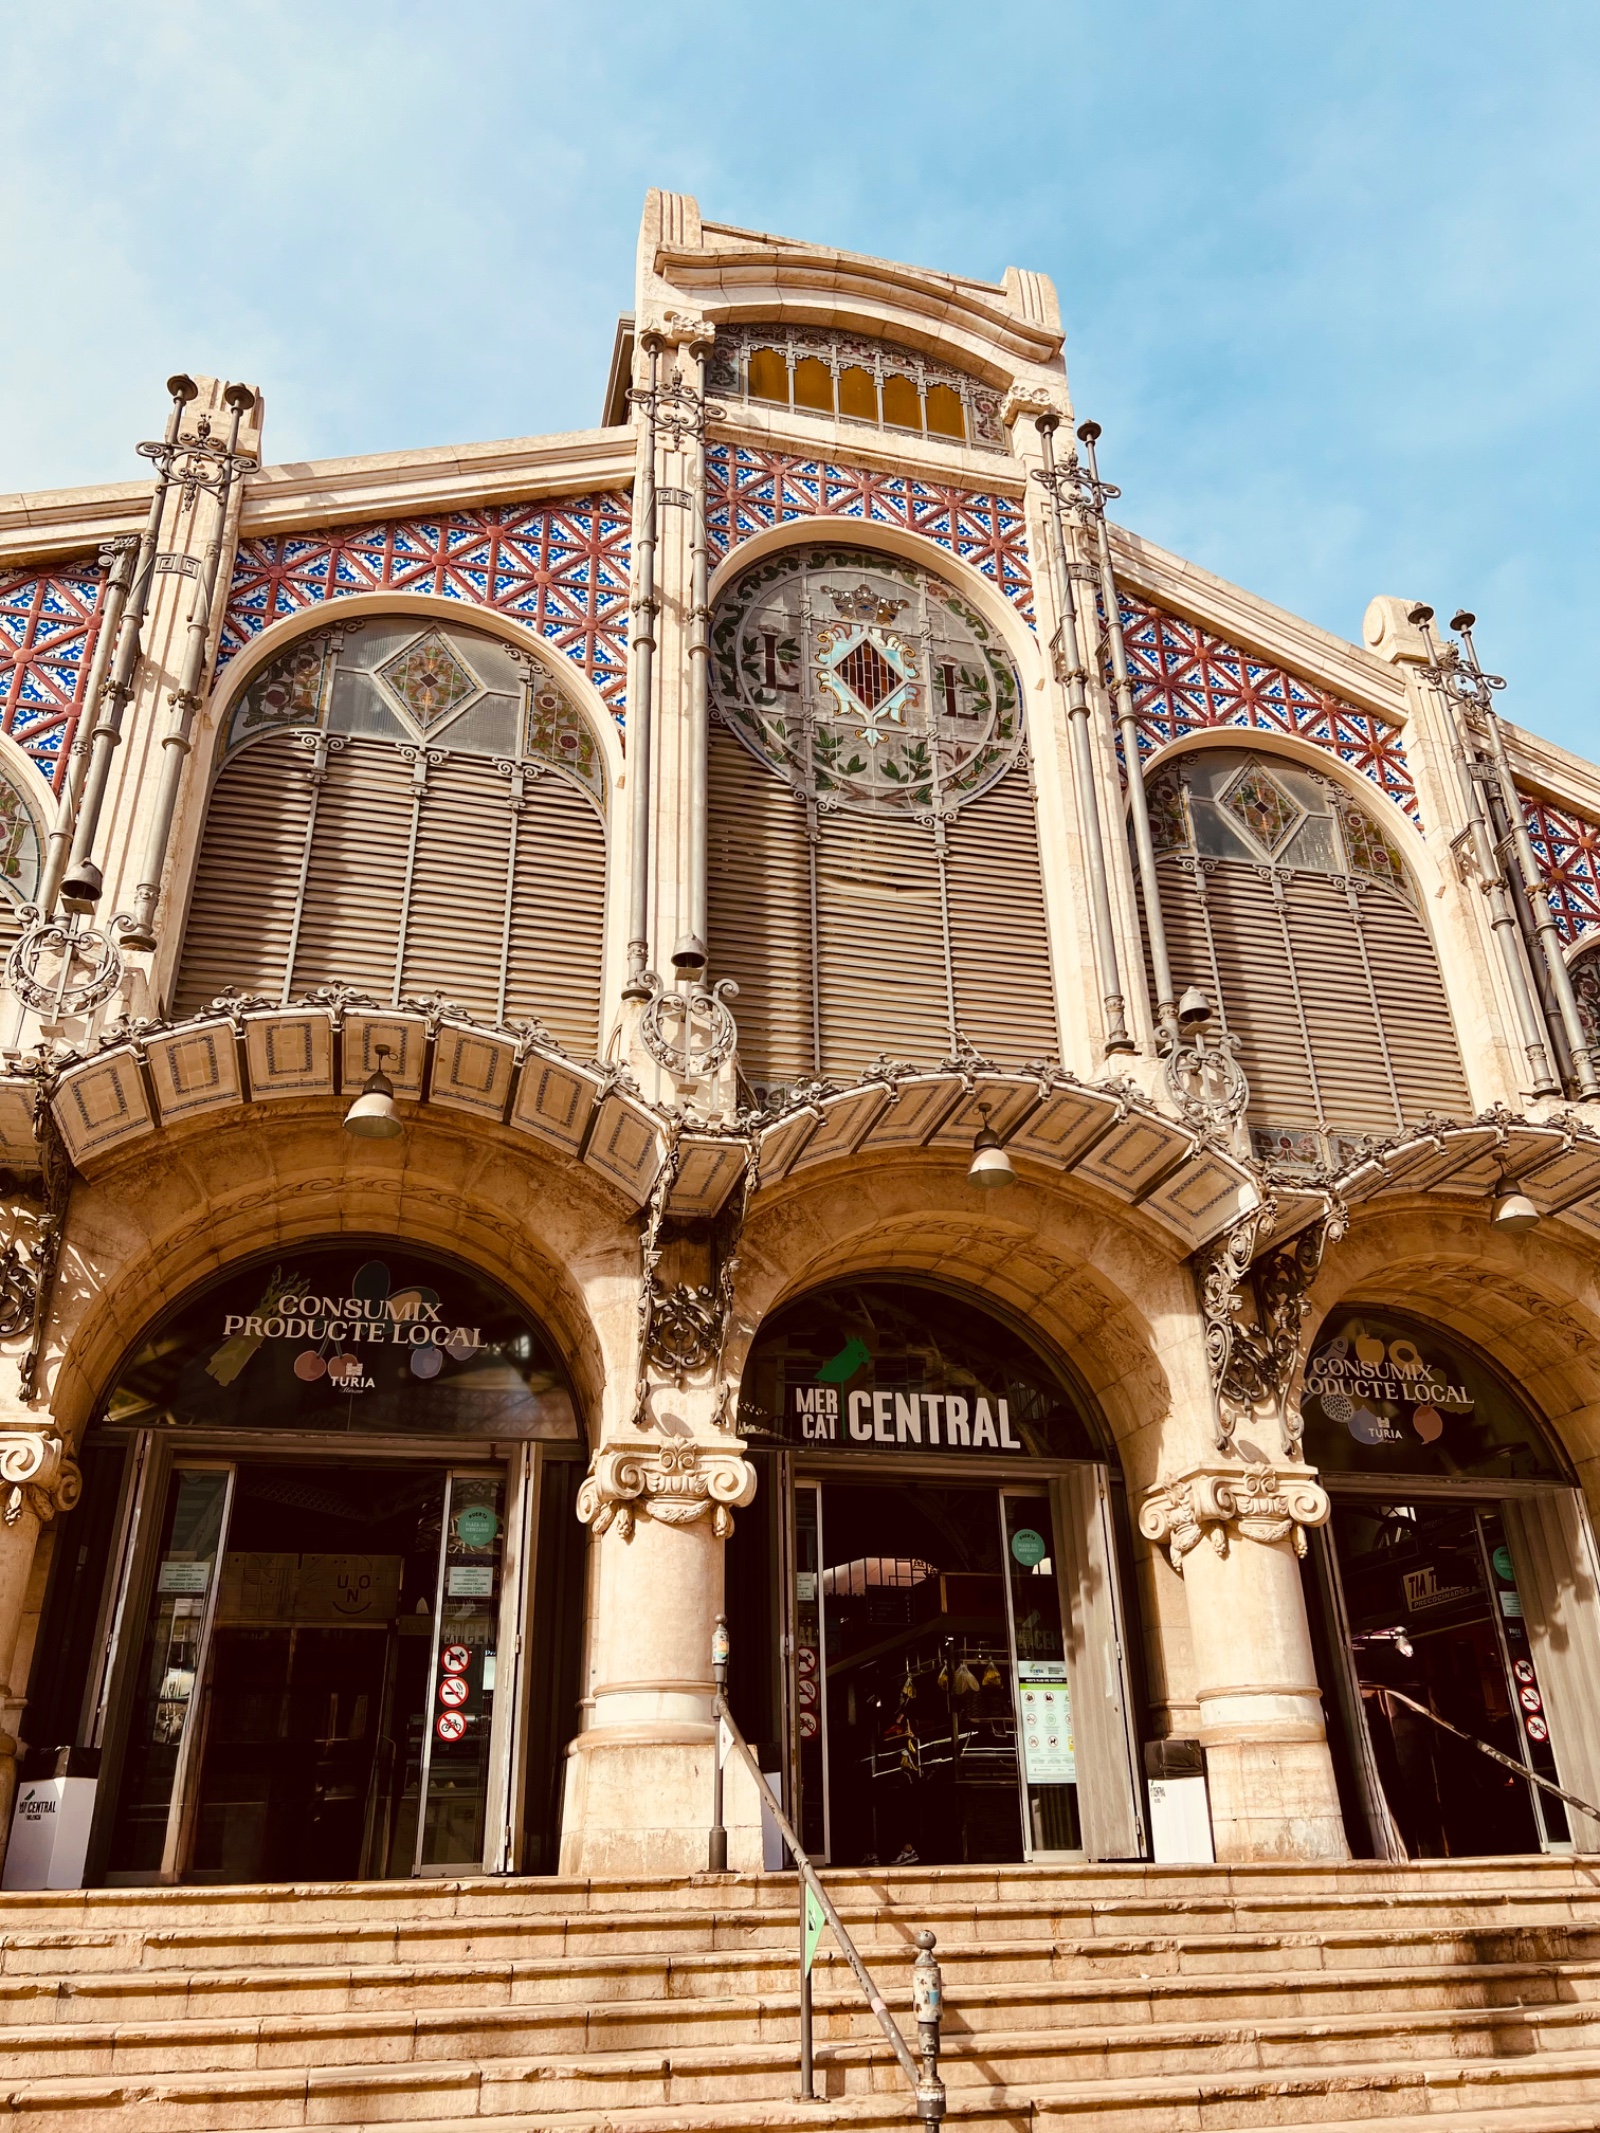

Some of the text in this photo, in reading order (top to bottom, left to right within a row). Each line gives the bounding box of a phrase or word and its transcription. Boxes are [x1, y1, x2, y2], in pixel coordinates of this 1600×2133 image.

[278, 1294, 443, 1323] CONSUMIX
[222, 1315, 488, 1348] PRODUCTE LOCAL
[331, 1376, 376, 1388] TURIA
[1313, 1357, 1435, 1382] CONSUMIX
[796, 1388, 838, 1414] MER
[1302, 1377, 1475, 1404] ODUCTE LOCAL
[802, 1414, 838, 1440] CAT
[848, 1390, 1021, 1449] CENTRAL
[1368, 1428, 1403, 1439] TURIA
[468, 1511, 488, 1519] PUERTA
[1408, 1573, 1427, 1599] TIA
[1414, 1586, 1470, 1608] PRECOCINADOS
[27, 1801, 56, 1813] CENTRAL
